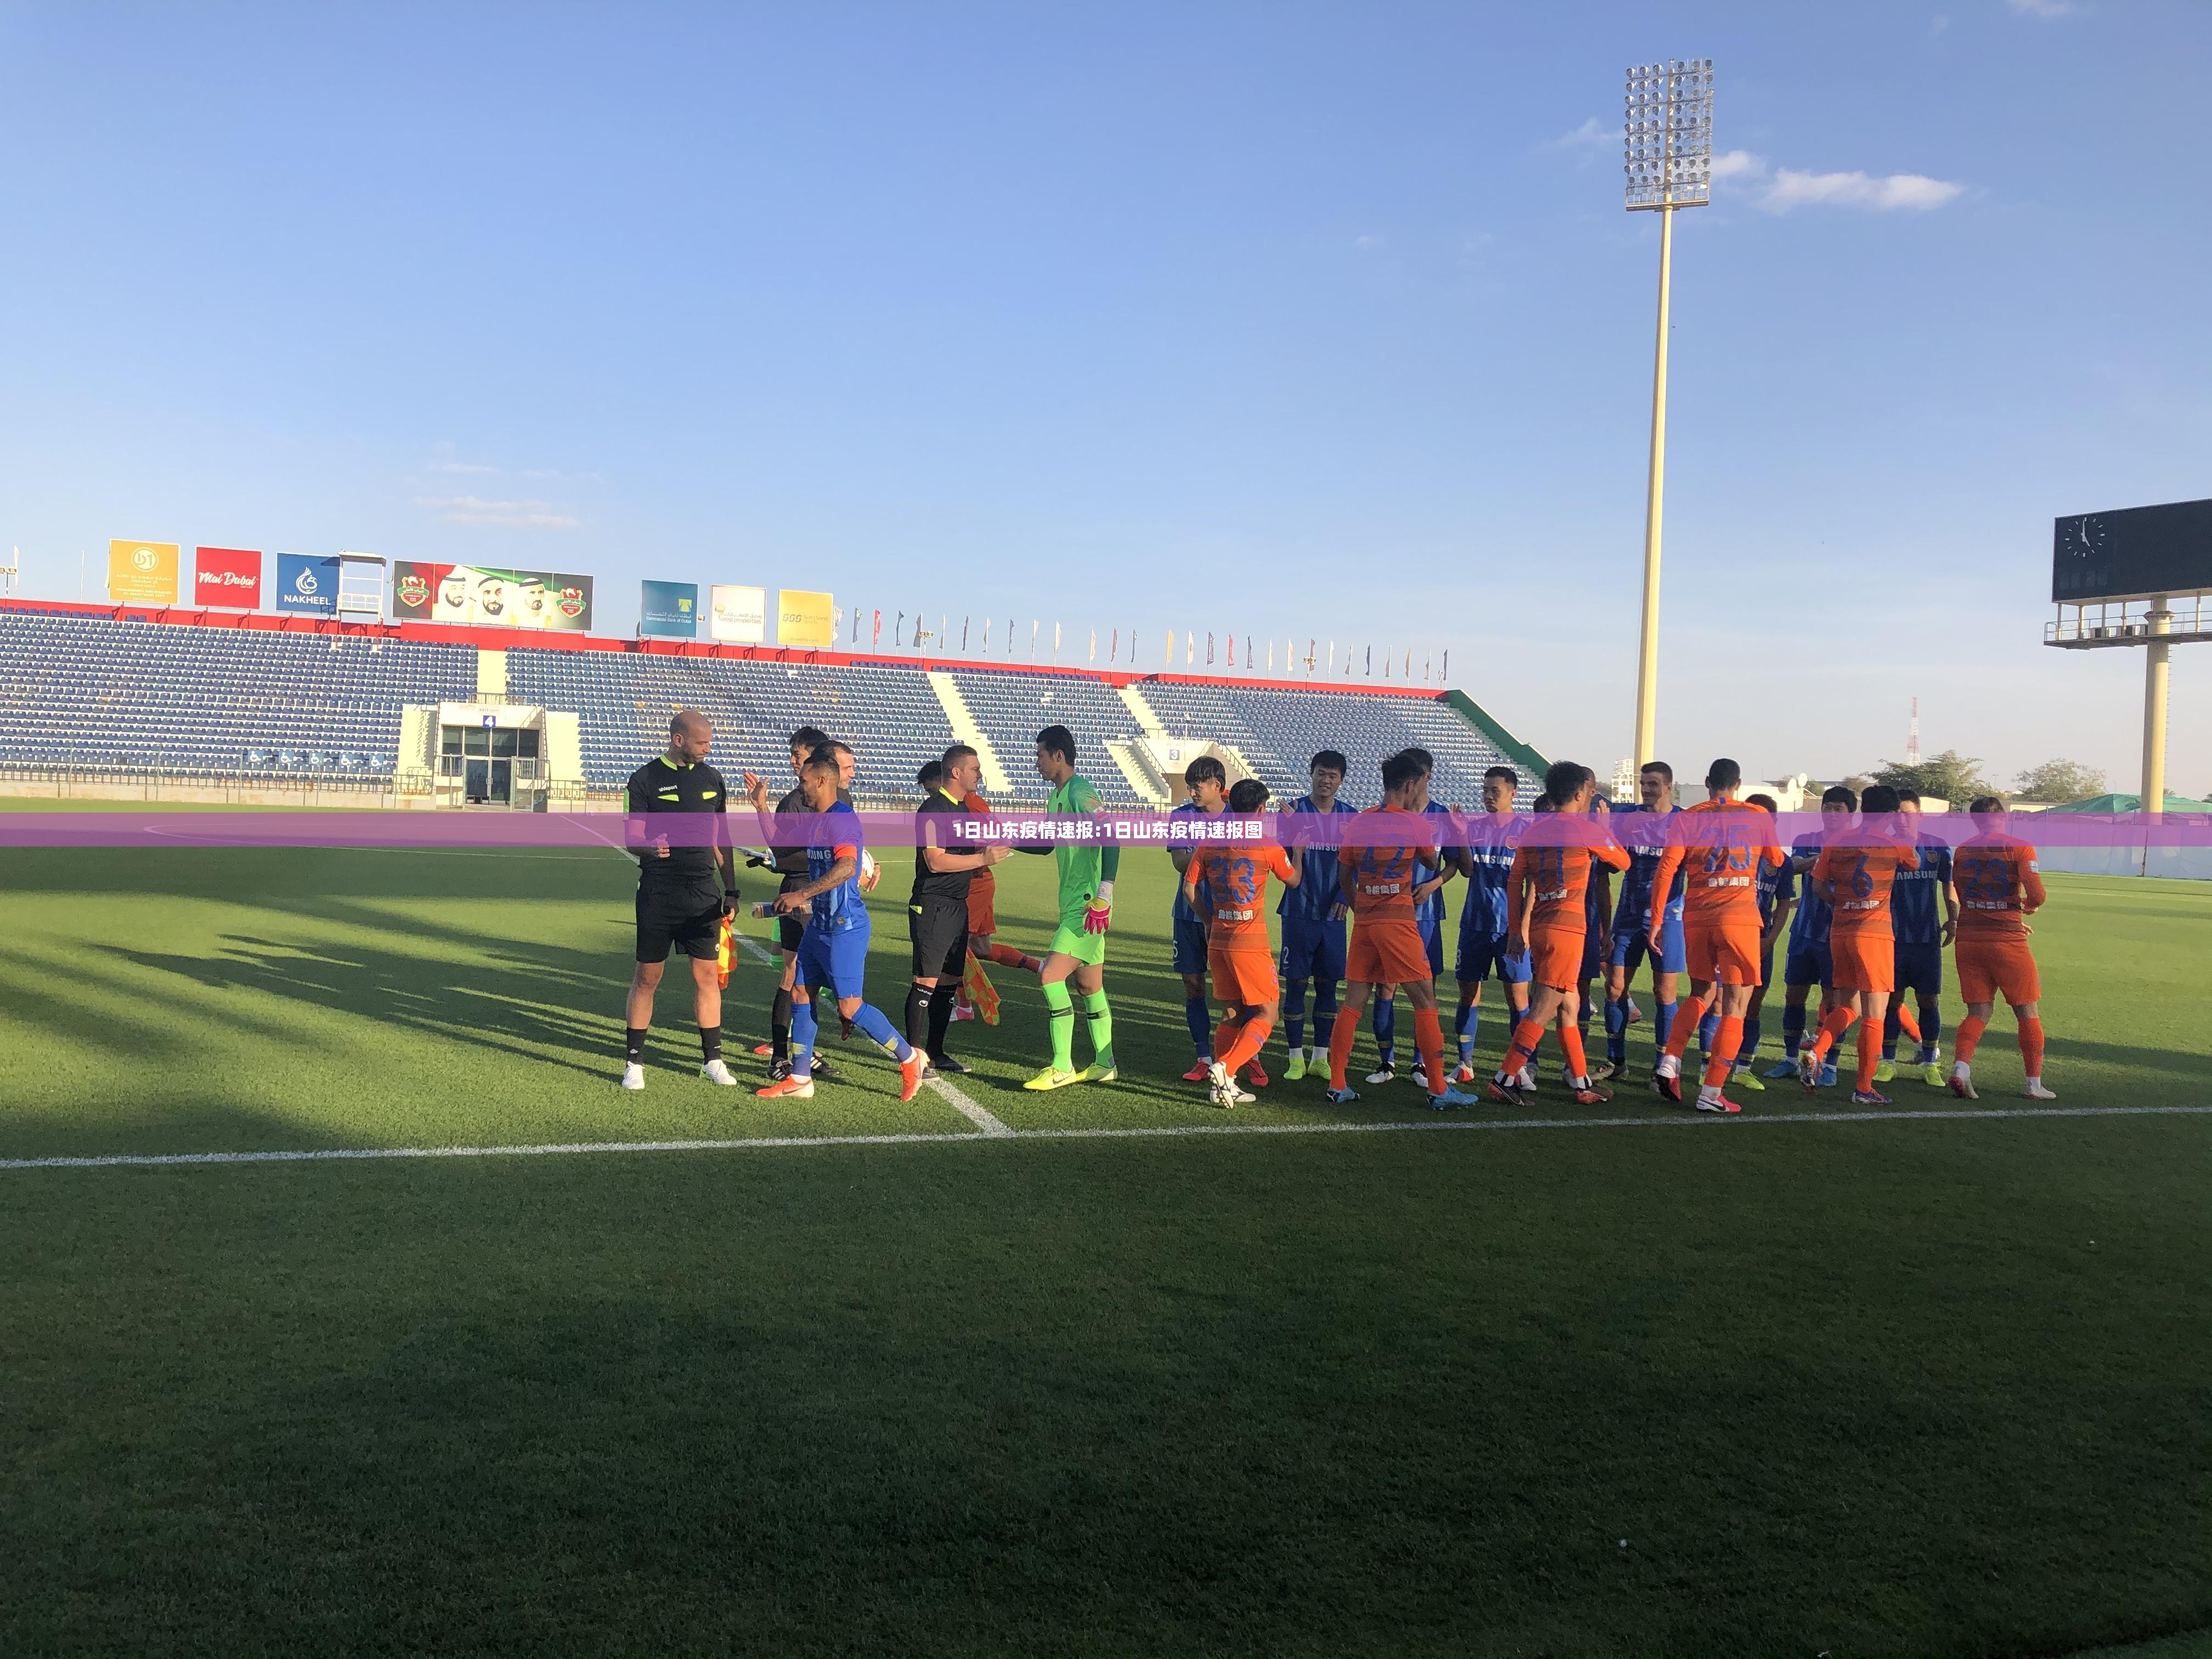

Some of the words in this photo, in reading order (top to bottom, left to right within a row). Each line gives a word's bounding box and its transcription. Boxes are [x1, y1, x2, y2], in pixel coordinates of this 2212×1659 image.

[198, 572, 223, 584] Mai
[223, 572, 257, 586] Dubai
[284, 594, 331, 606] NAKHEEL
[484, 716, 494, 727] 4
[1171, 749, 1178, 760] 3
[807, 849, 831, 860] UNG
[1360, 833, 1405, 879] 42
[1701, 825, 1752, 872] 25
[1473, 854, 1515, 866] AMSUN
[1538, 842, 1564, 887] 11
[1211, 856, 1256, 905] 33
[1853, 855, 1874, 898] 6
[1963, 858, 2010, 899] 23
[1283, 946, 1289, 964] 2
